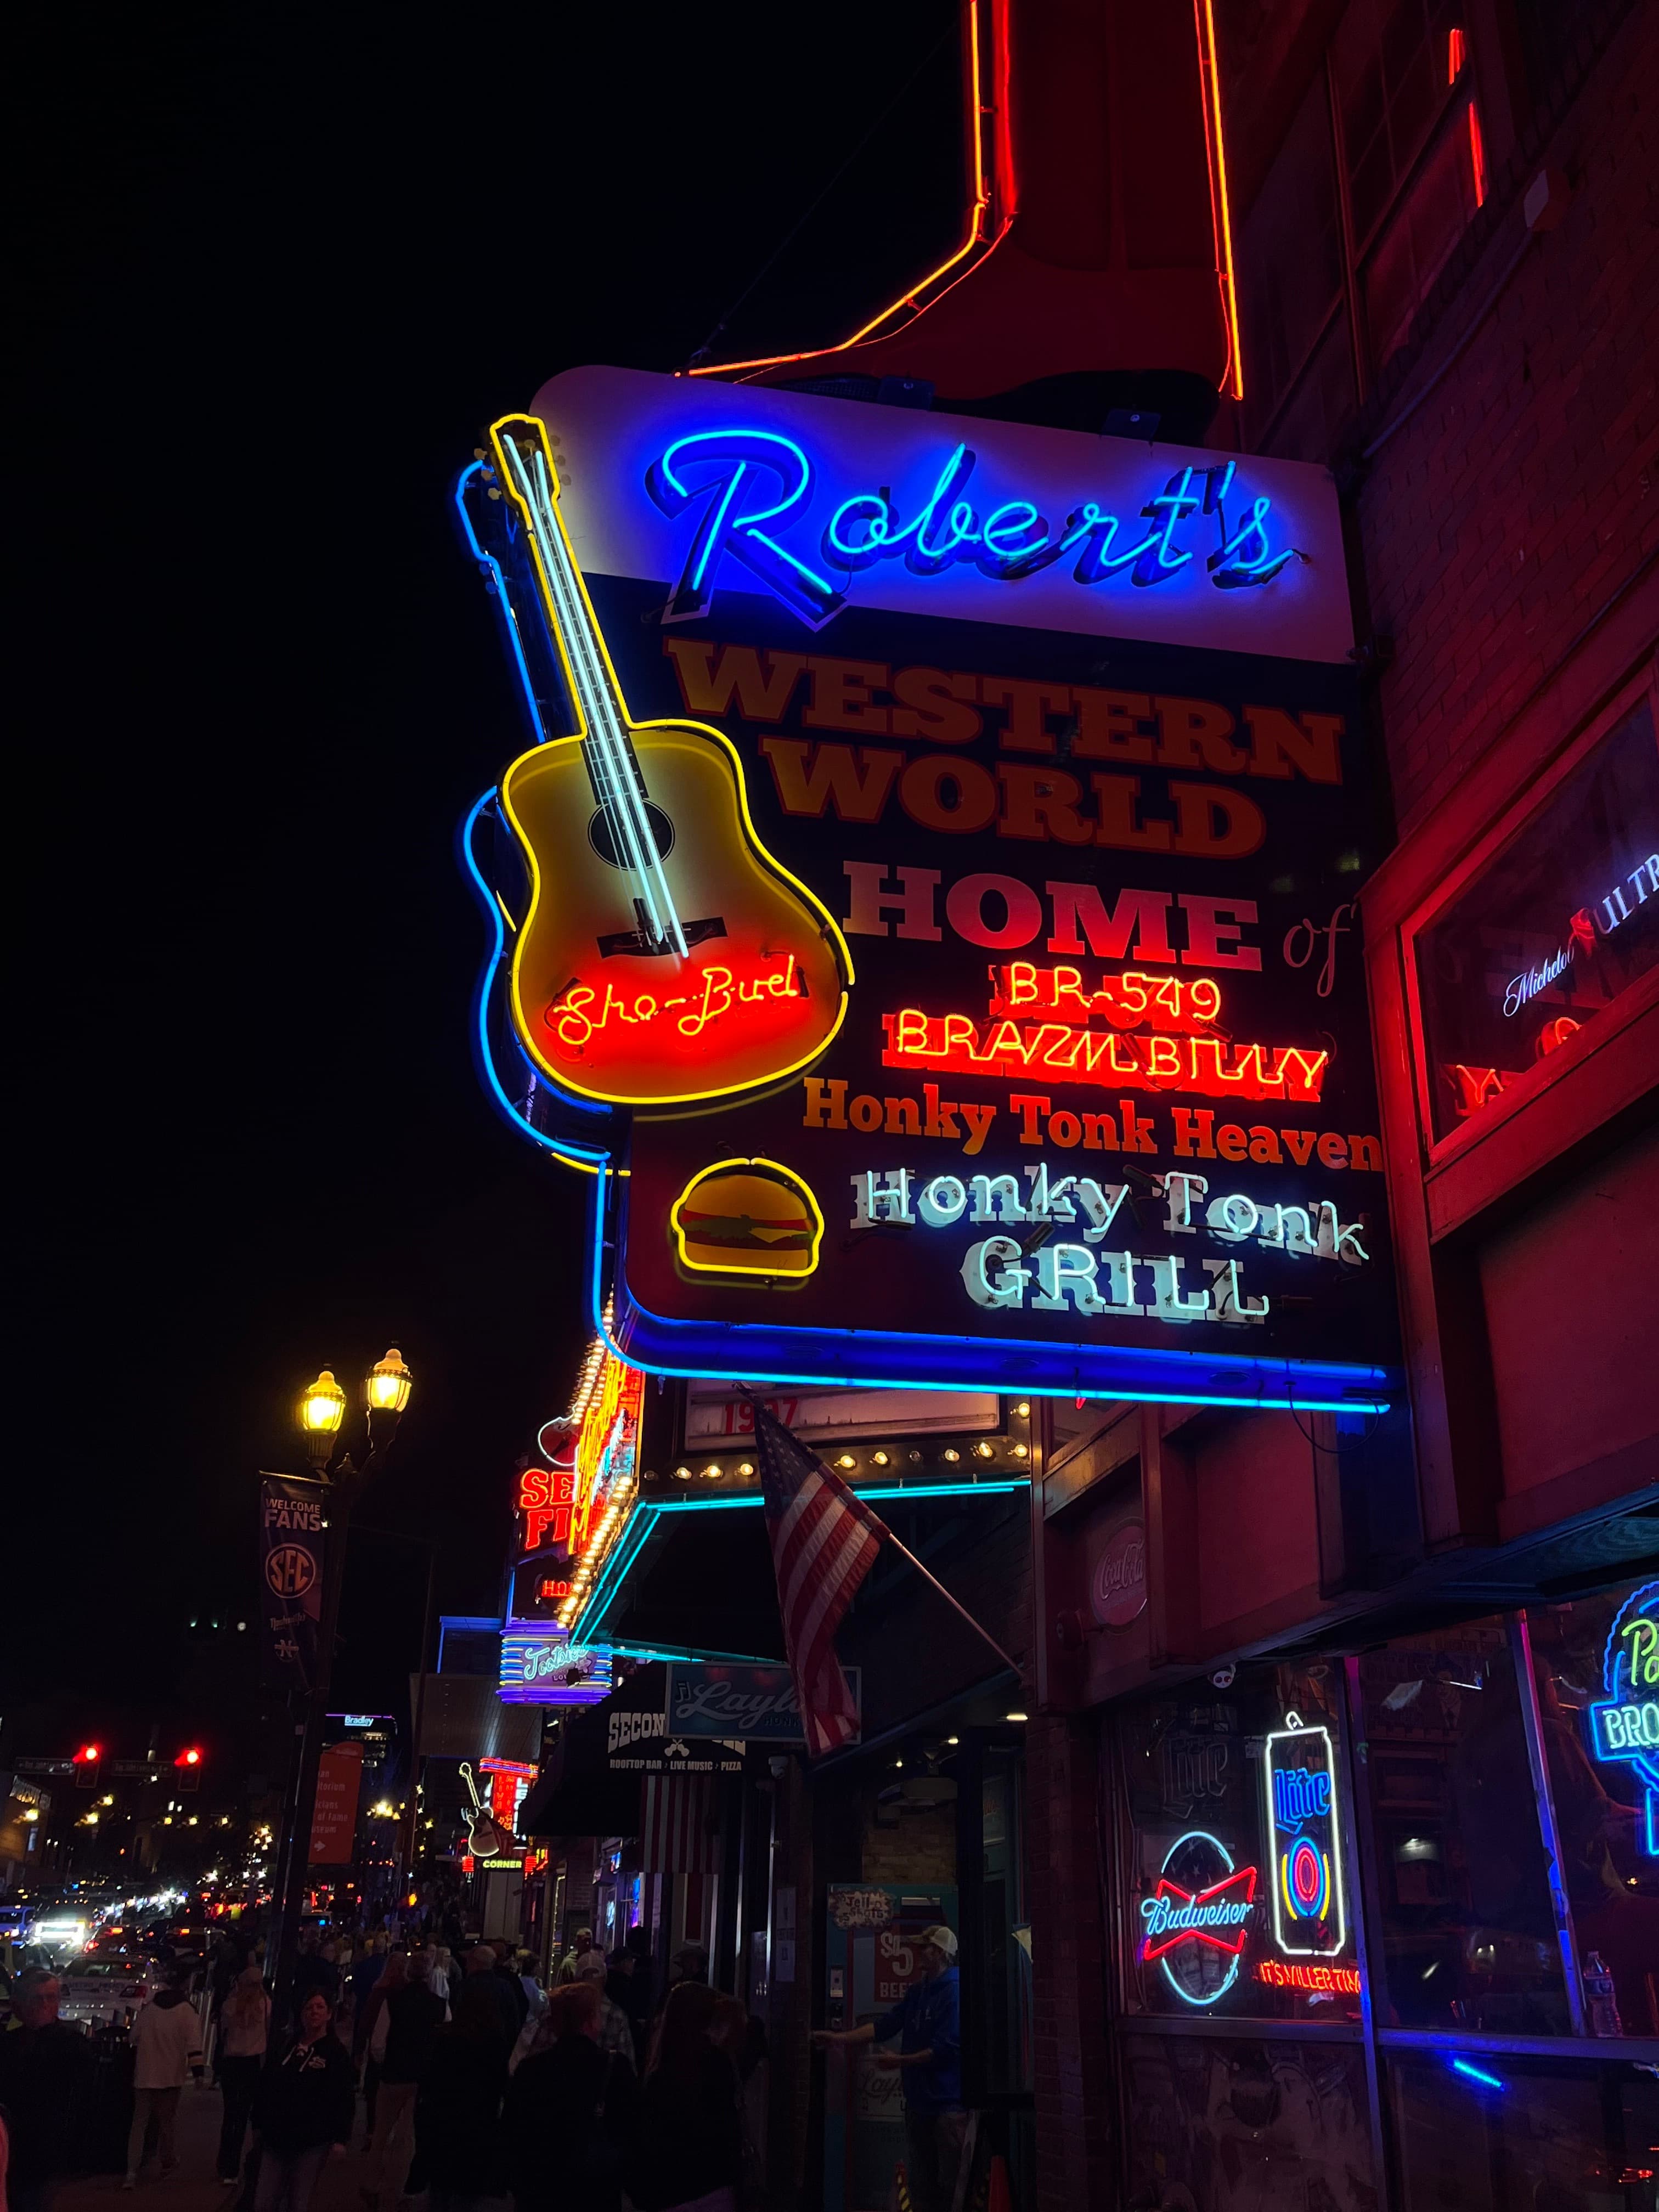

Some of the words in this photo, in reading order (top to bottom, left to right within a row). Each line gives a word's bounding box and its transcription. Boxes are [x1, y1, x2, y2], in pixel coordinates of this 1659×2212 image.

[646, 430, 1297, 631] Robert's
[664, 635, 1346, 785] WESTERN
[758, 734, 1267, 859] WORLD
[1594, 853, 1659, 935] ULTR
[843, 860, 1261, 972] HOME
[1283, 904, 1356, 997] of
[553, 953, 799, 1045] Sho-Bud
[803, 1077, 996, 1156] Honky
[1010, 1093, 1158, 1154] Tonk
[1172, 1108, 1385, 1172] Heaven
[850, 1163, 1129, 1243] Honky
[1158, 1170, 1369, 1266] Tonk
[959, 1234, 1269, 1325] GRILL
[264, 1497, 321, 1514] WELCOME
[264, 1510, 322, 1532] FANS
[269, 1549, 311, 1593] SEC
[345, 1715, 374, 1726] Bradley
[675, 1681, 802, 1730] Layl
[763, 1716, 799, 1726] HONK
[607, 1712, 666, 1754] SECON
[610, 1759, 644, 1769] ROOFTOP
[646, 1759, 662, 1770] BAR
[670, 1760, 686, 1770] LIVE
[687, 1760, 713, 1771] MUSIC
[721, 1760, 742, 1771] PIZZA
[483, 1859, 522, 1868] CORNER
[1141, 1894, 1254, 1936] Budweiser
[880, 1931, 914, 1977] $5
[1260, 1959, 1284, 1986] IT'S
[1332, 1968, 1361, 1994] TIM
